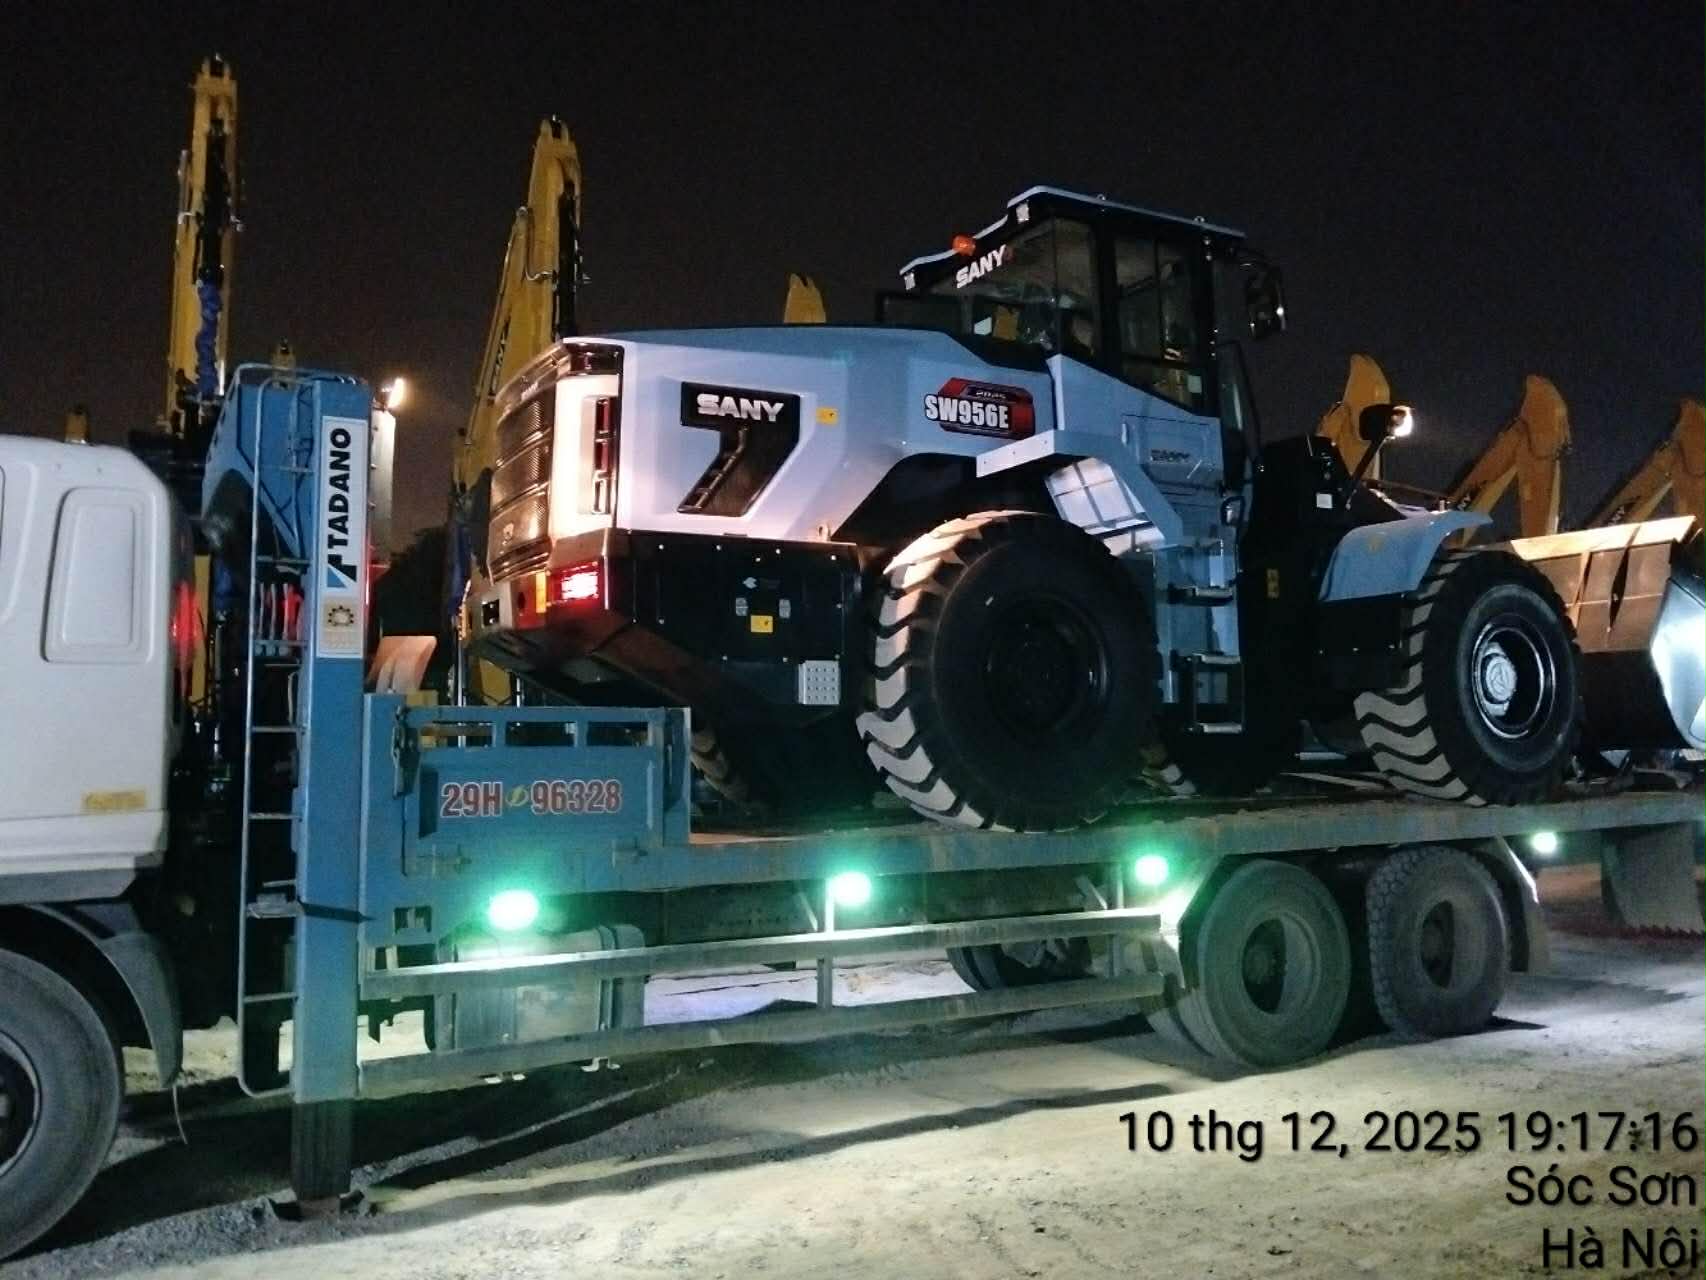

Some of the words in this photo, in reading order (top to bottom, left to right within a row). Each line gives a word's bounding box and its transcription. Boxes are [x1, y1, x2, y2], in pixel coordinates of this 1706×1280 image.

[956, 244, 1007, 289] SANY
[697, 393, 784, 422] SANY
[923, 393, 1010, 430] SW956E
[327, 427, 351, 549] TADANO
[440, 781, 503, 818] 29H
[530, 779, 622, 815] 96328
